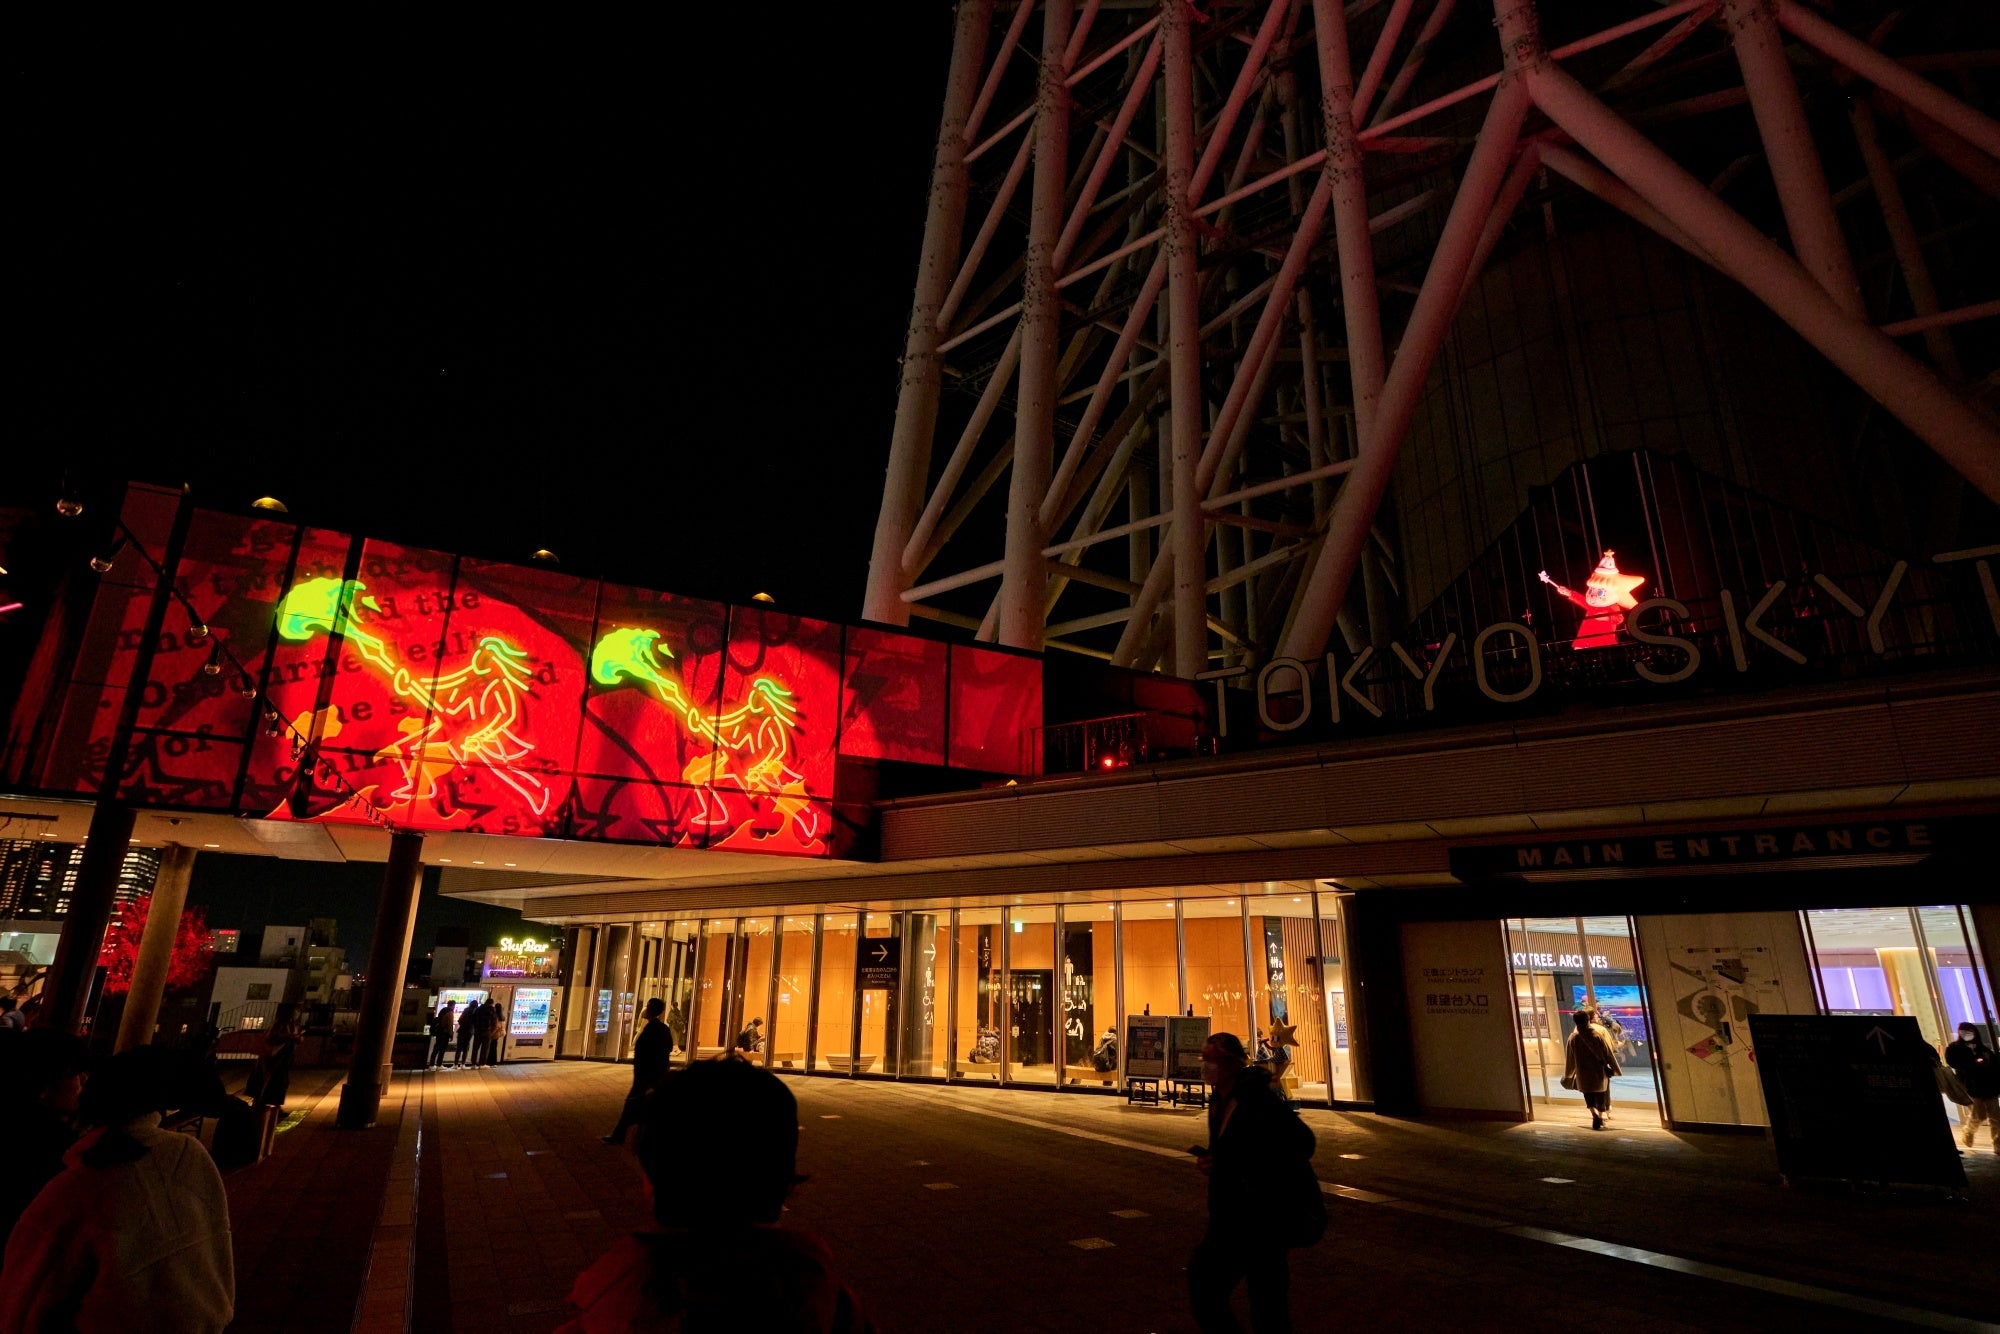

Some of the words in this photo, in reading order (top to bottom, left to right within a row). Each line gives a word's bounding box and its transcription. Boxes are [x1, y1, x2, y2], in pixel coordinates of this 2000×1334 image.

[1195, 621, 1543, 737] TOKYO
[1516, 843, 1625, 868] MAIN
[1654, 823, 1932, 861] ENTRANCE
[500, 937, 524, 955] Sky
[523, 938, 549, 952] Bar
[1559, 954, 1608, 968] ARCVES
